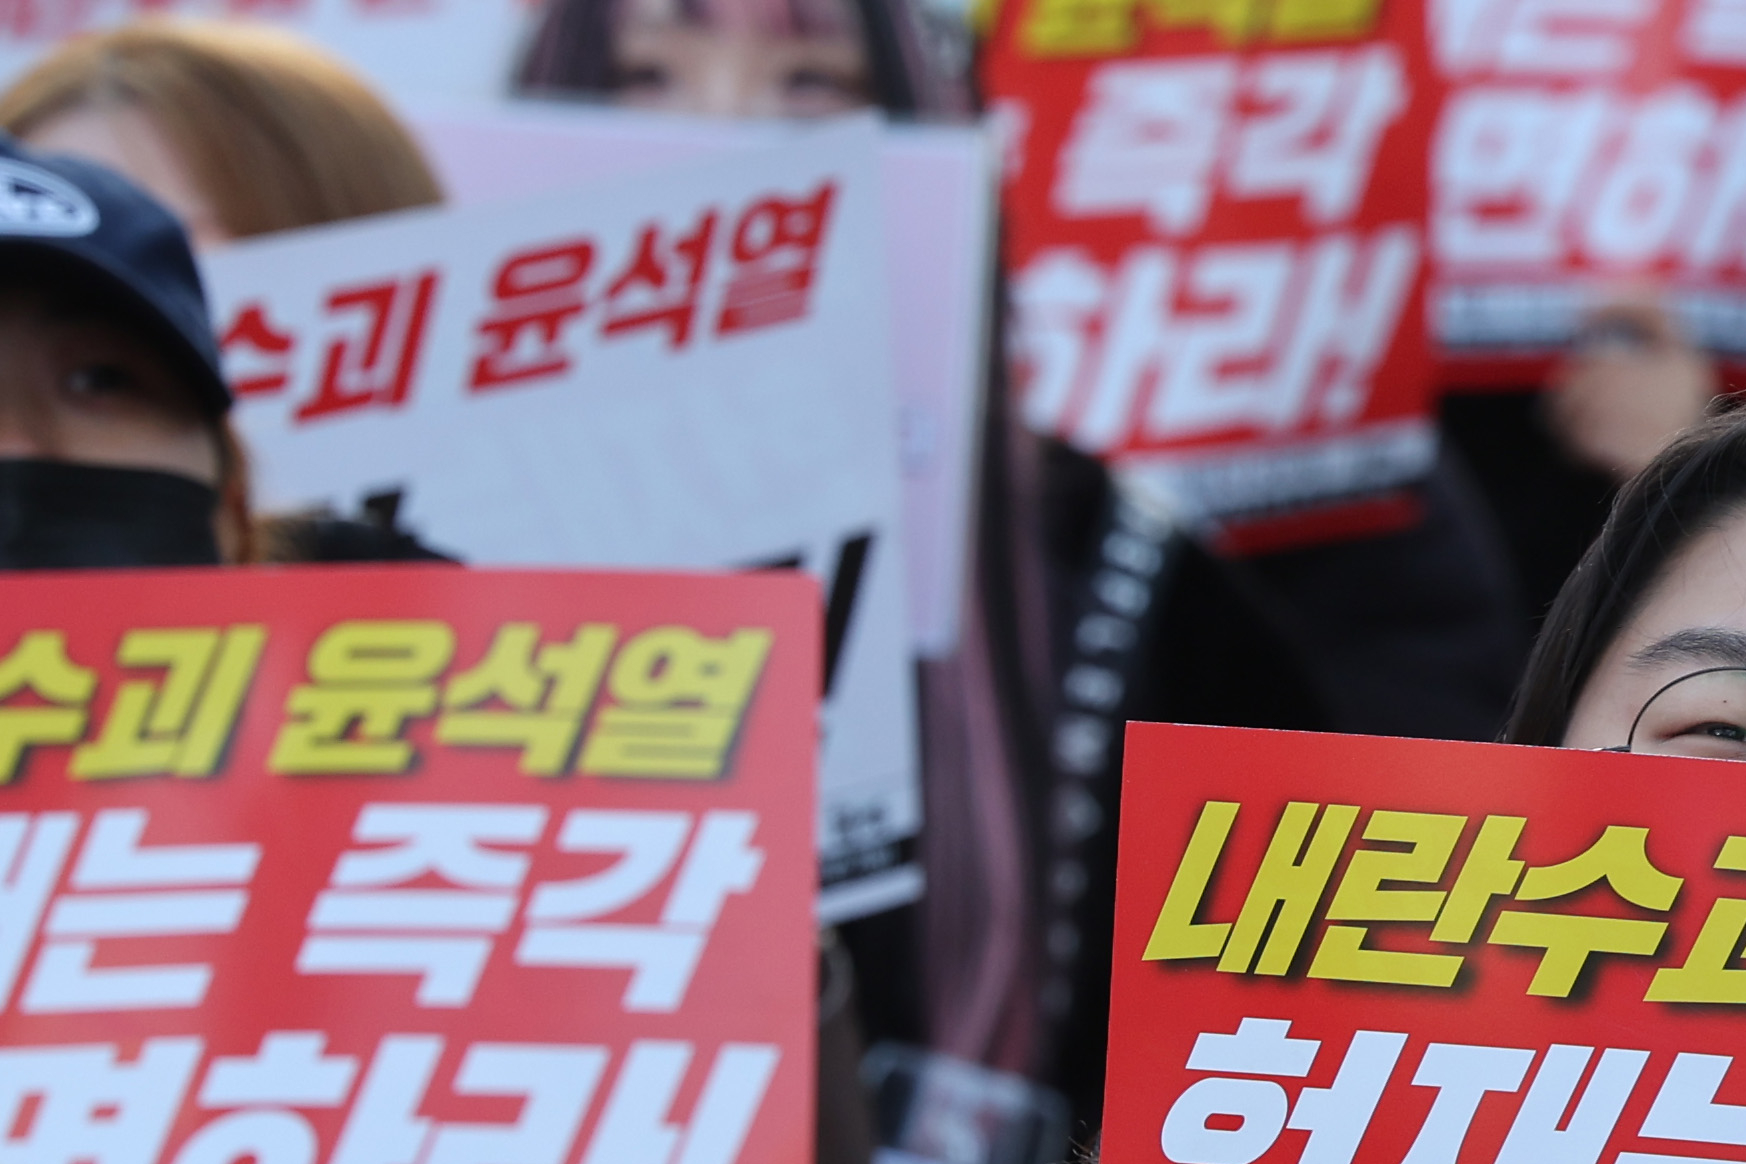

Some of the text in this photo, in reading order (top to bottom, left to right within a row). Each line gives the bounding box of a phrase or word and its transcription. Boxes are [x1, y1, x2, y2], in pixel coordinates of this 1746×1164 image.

[464, 180, 841, 394] 윤석열
[267, 620, 775, 779] 윤석열
[294, 803, 767, 1012] 즉각
